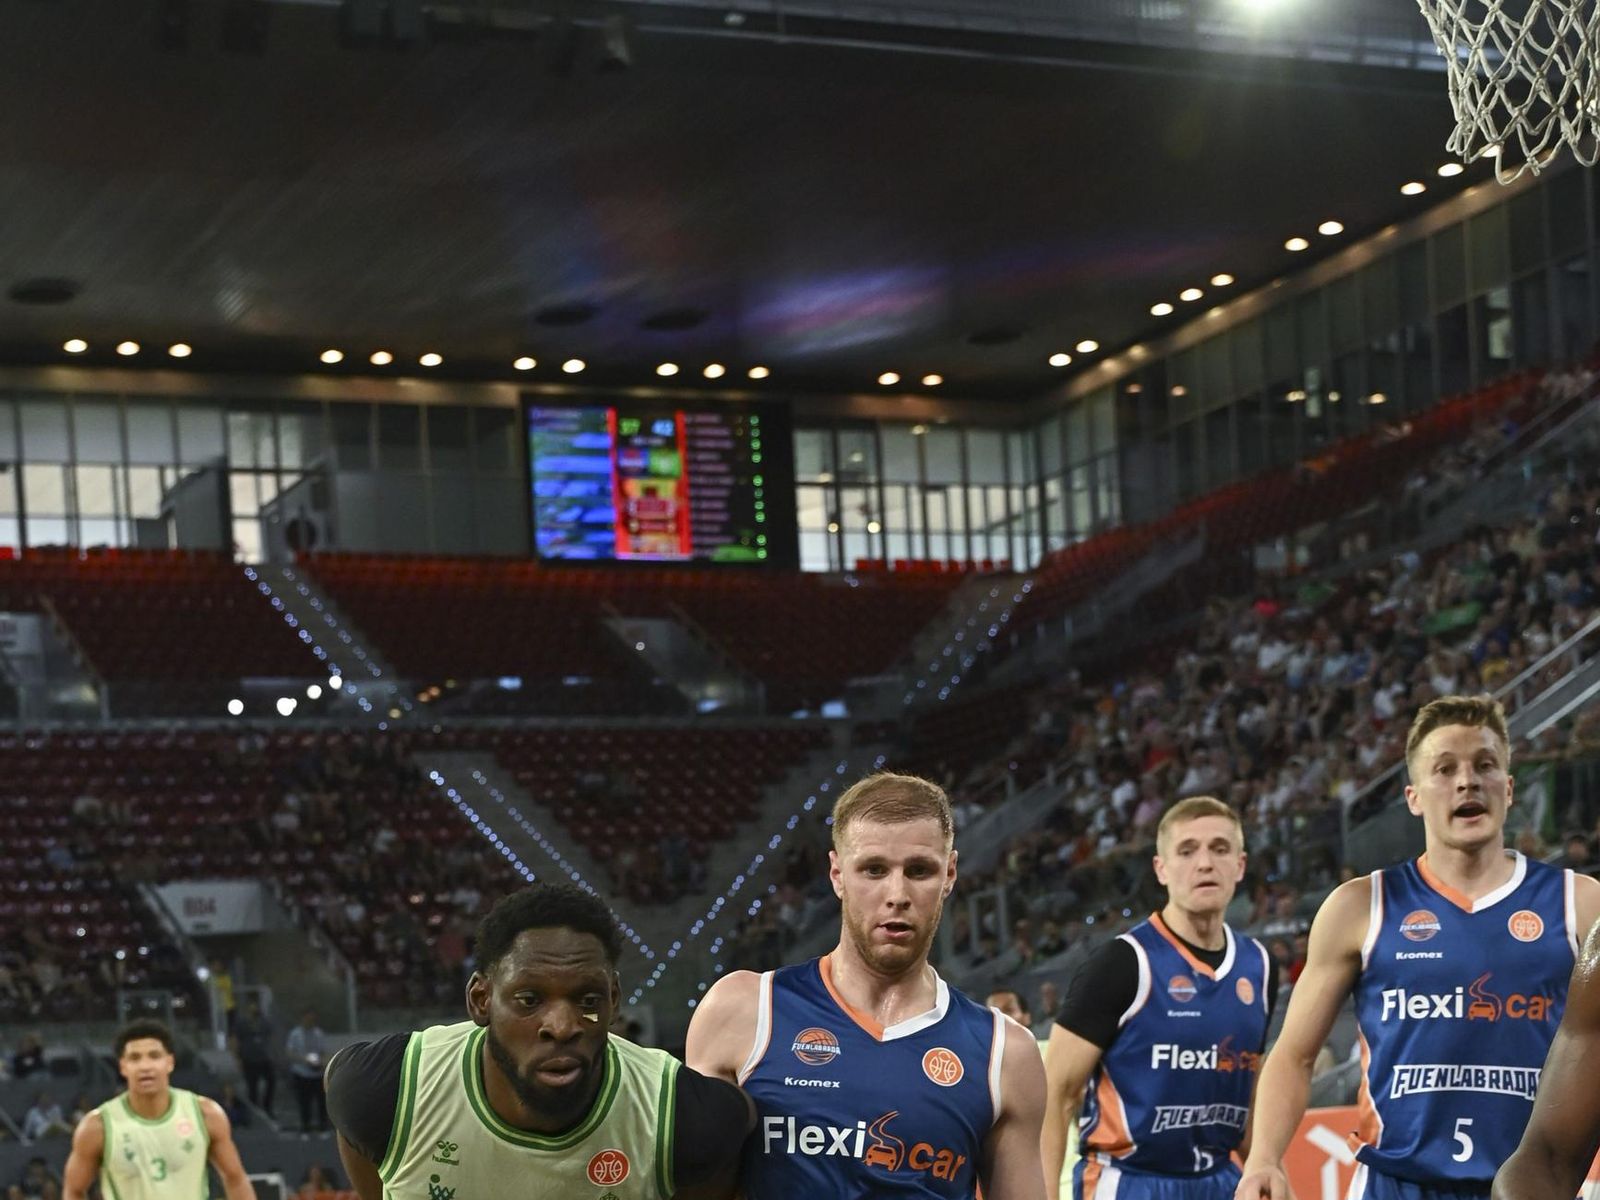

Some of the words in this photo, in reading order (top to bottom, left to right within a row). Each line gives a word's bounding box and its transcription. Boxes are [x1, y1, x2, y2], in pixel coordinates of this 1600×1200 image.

[1395, 951, 1443, 961] Kromex
[1381, 986, 1464, 1022] Flexi
[791, 1042, 841, 1055] FUENLABRADA
[1151, 1044, 1218, 1070] Flexi
[784, 1077, 841, 1088] Kromex
[1390, 1064, 1543, 1101] FUENLABRADA
[763, 1116, 867, 1158] Flexi
[908, 1142, 966, 1182] car
[1452, 1117, 1474, 1163] 5
[151, 1157, 167, 1182] 3
